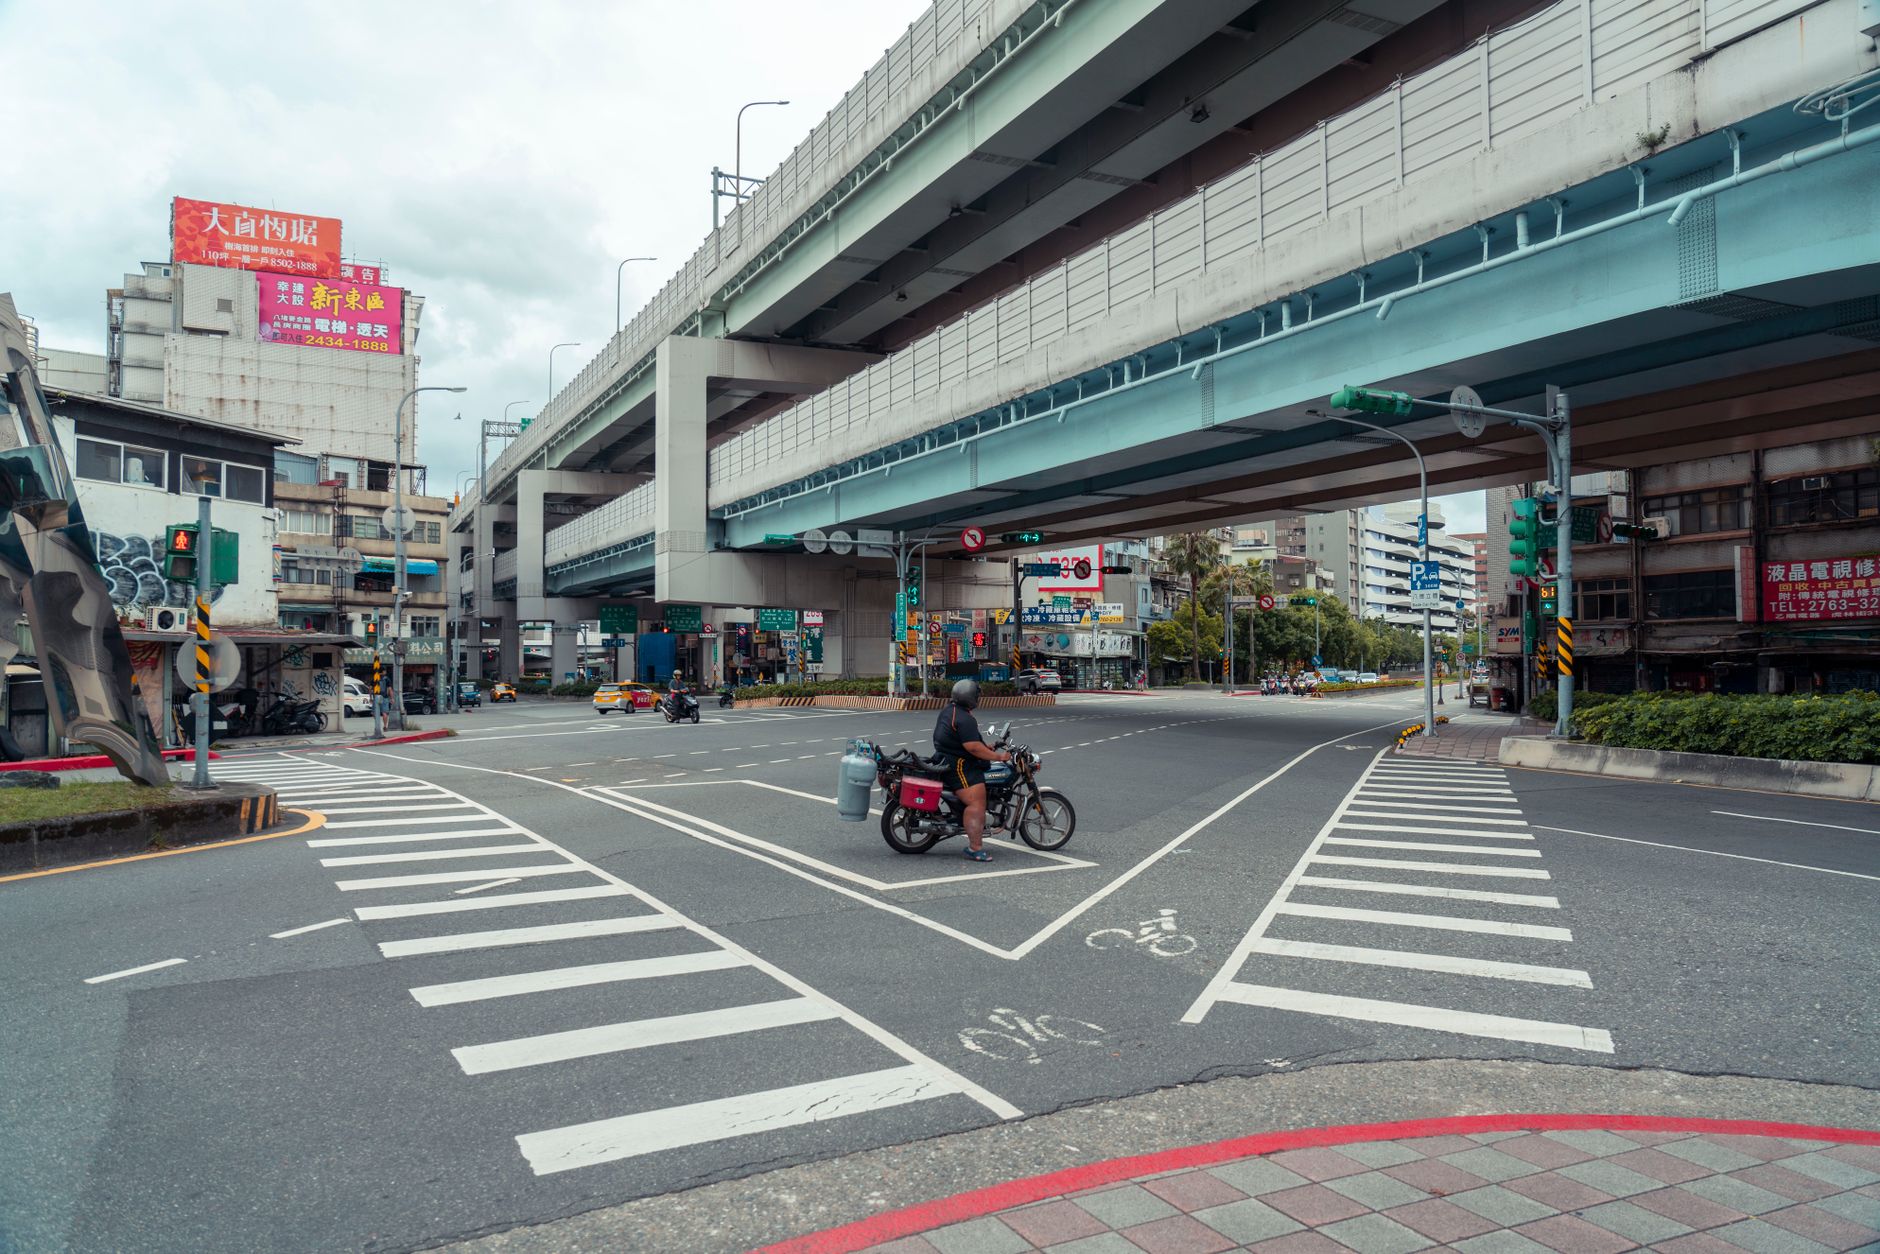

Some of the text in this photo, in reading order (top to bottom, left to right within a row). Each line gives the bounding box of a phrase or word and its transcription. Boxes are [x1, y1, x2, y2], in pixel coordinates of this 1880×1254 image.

[270, 258, 318, 271] 8502-1888
[310, 281, 385, 316] 新東區
[305, 335, 389, 352] 2434-1888
[1412, 564, 1425, 581] P
[1767, 559, 1880, 582] 液晶電視修
[1498, 627, 1520, 637] SYM
